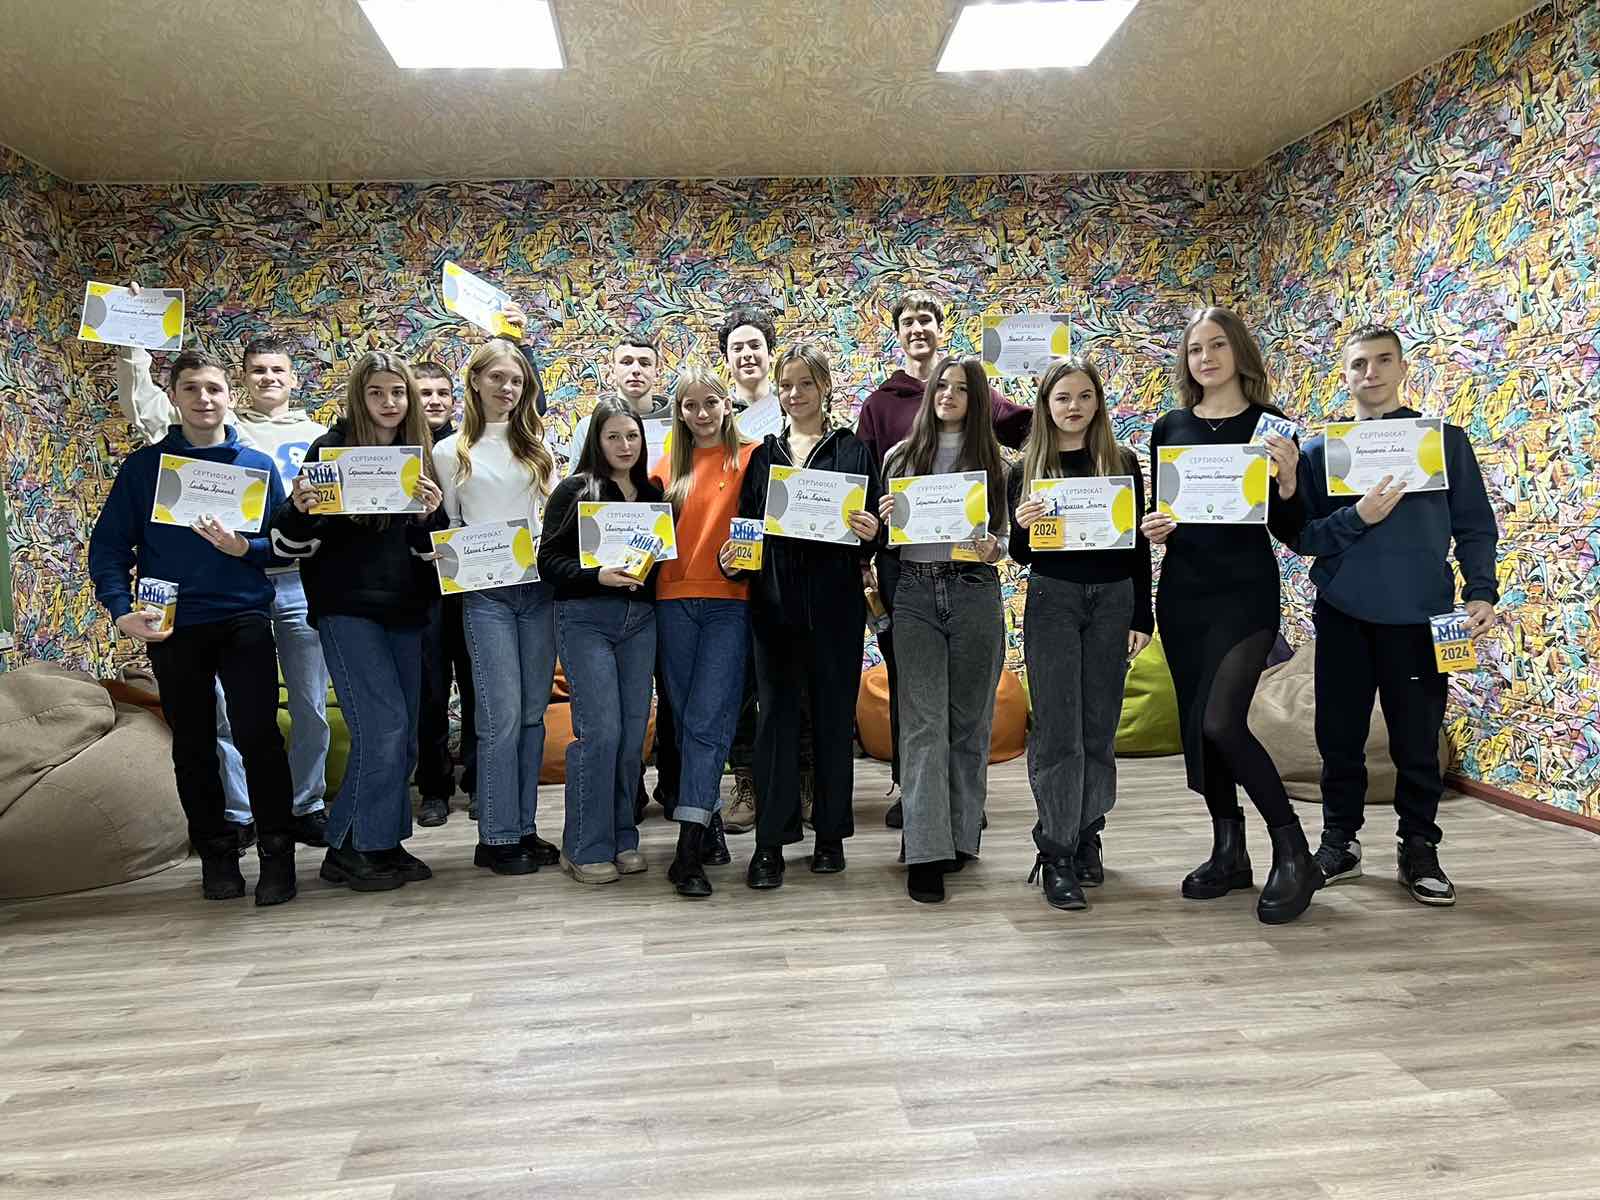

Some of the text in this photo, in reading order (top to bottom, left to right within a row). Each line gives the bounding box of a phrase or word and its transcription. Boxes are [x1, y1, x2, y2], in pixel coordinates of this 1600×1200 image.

[1360, 430, 1407, 440] СЕРТИФІКАТ
[350, 455, 393, 463] СЕРТИФІКАТ
[1190, 456, 1233, 464] СЕРТИФІКАТ
[192, 469, 237, 481] СЕРТИФІКАТ
[308, 464, 334, 485] МІЙ
[798, 479, 839, 489] СЕРТИФІКАТ
[318, 487, 336, 503] 024
[462, 530, 504, 541] СЕРТИФІКАТ
[733, 523, 755, 540] МІЙ
[1033, 523, 1057, 536] 2024
[630, 533, 655, 551] МІЙ
[735, 546, 752, 559] 024
[141, 585, 166, 604] МІЙ
[1441, 646, 1470, 661] 2024
